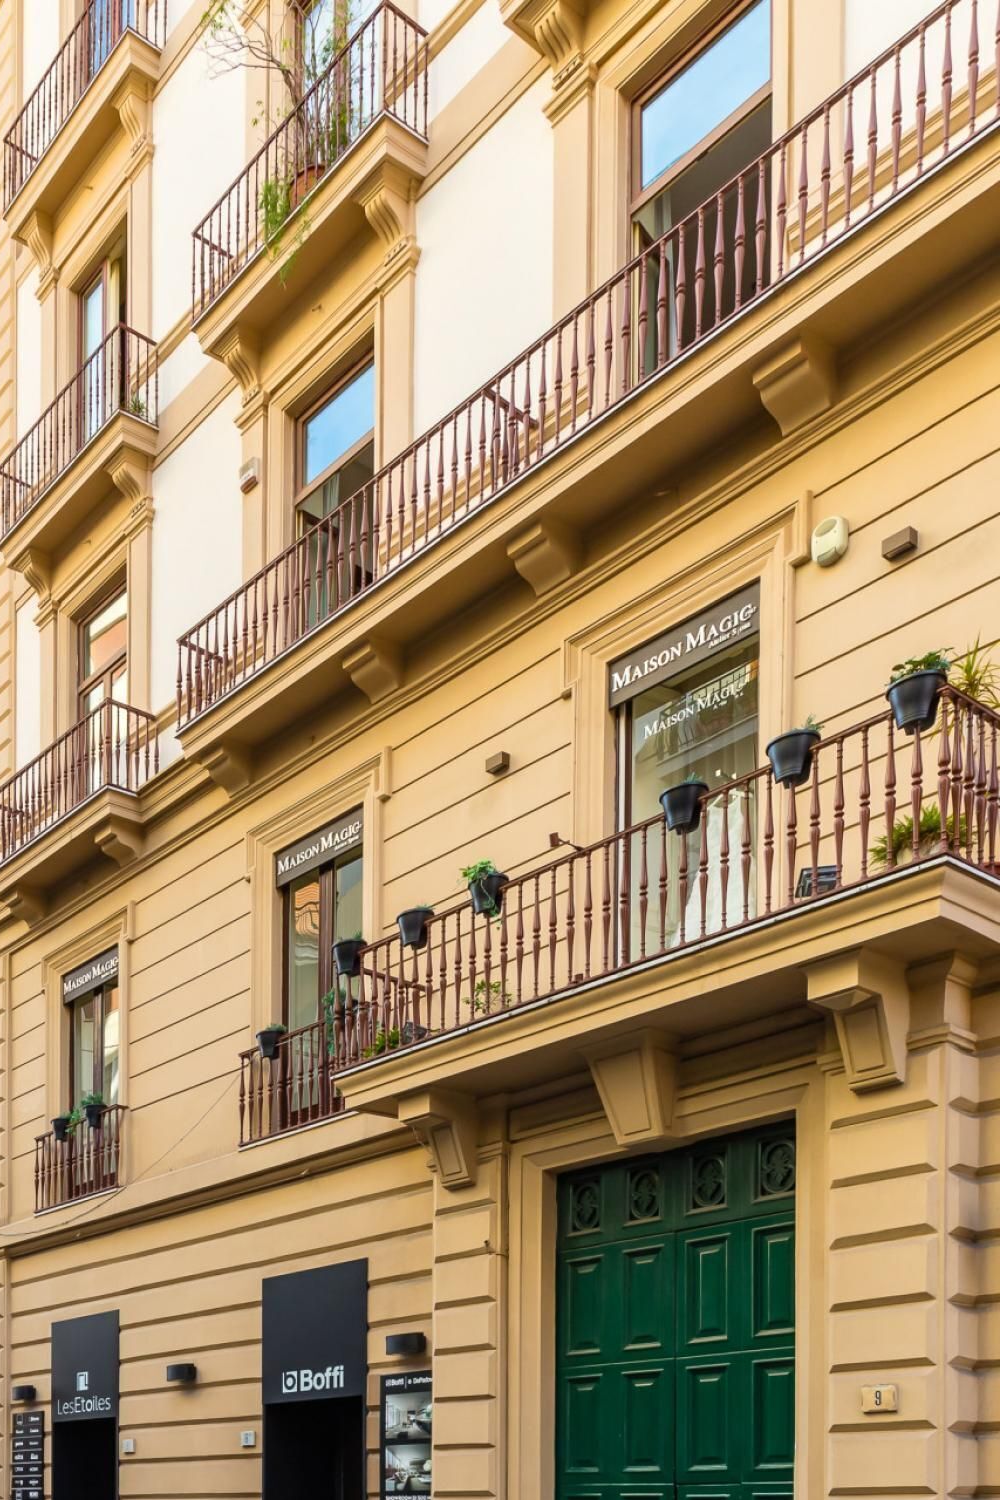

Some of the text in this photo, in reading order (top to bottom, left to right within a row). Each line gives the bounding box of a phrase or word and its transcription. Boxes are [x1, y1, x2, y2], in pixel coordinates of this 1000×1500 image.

[611, 641, 682, 693] MAISON
[643, 704, 694, 740] MAISON
[277, 843, 320, 876] MAISON
[63, 971, 92, 996] MAISON
[299, 1365, 345, 1392] Boffi
[57, 1395, 112, 1416] LesEtoiles
[875, 1390, 882, 1406] 9
